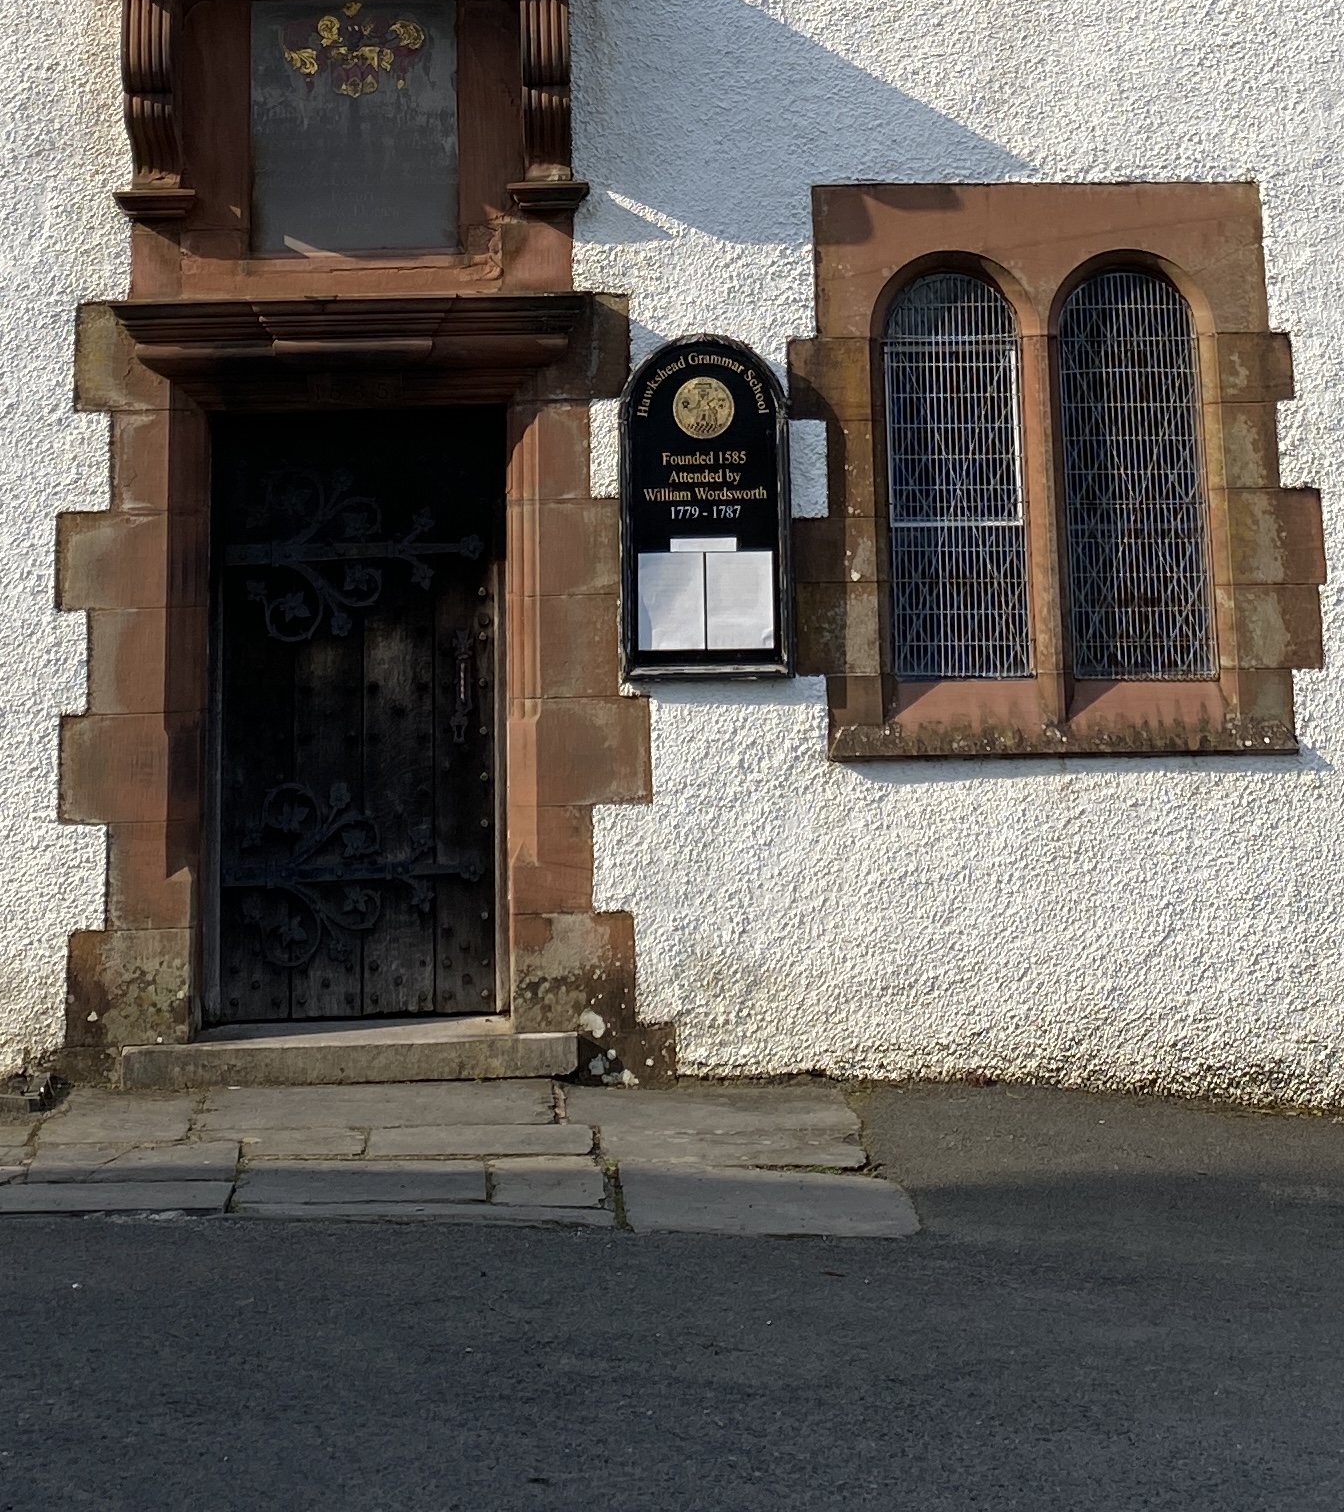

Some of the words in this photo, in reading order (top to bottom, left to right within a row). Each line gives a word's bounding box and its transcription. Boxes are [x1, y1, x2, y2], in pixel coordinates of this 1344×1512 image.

[636, 356, 686, 417] Hawkshead
[688, 352, 745, 374] Grammar
[743, 369, 770, 414] School
[661, 451, 714, 466] Founded
[718, 450, 747, 465] 1585
[668, 468, 723, 483] Attended
[725, 468, 742, 485] by
[643, 487, 692, 502] William
[694, 485, 768, 500] Wordsworth
[670, 505, 700, 520] 1779
[712, 505, 742, 519] 1787
